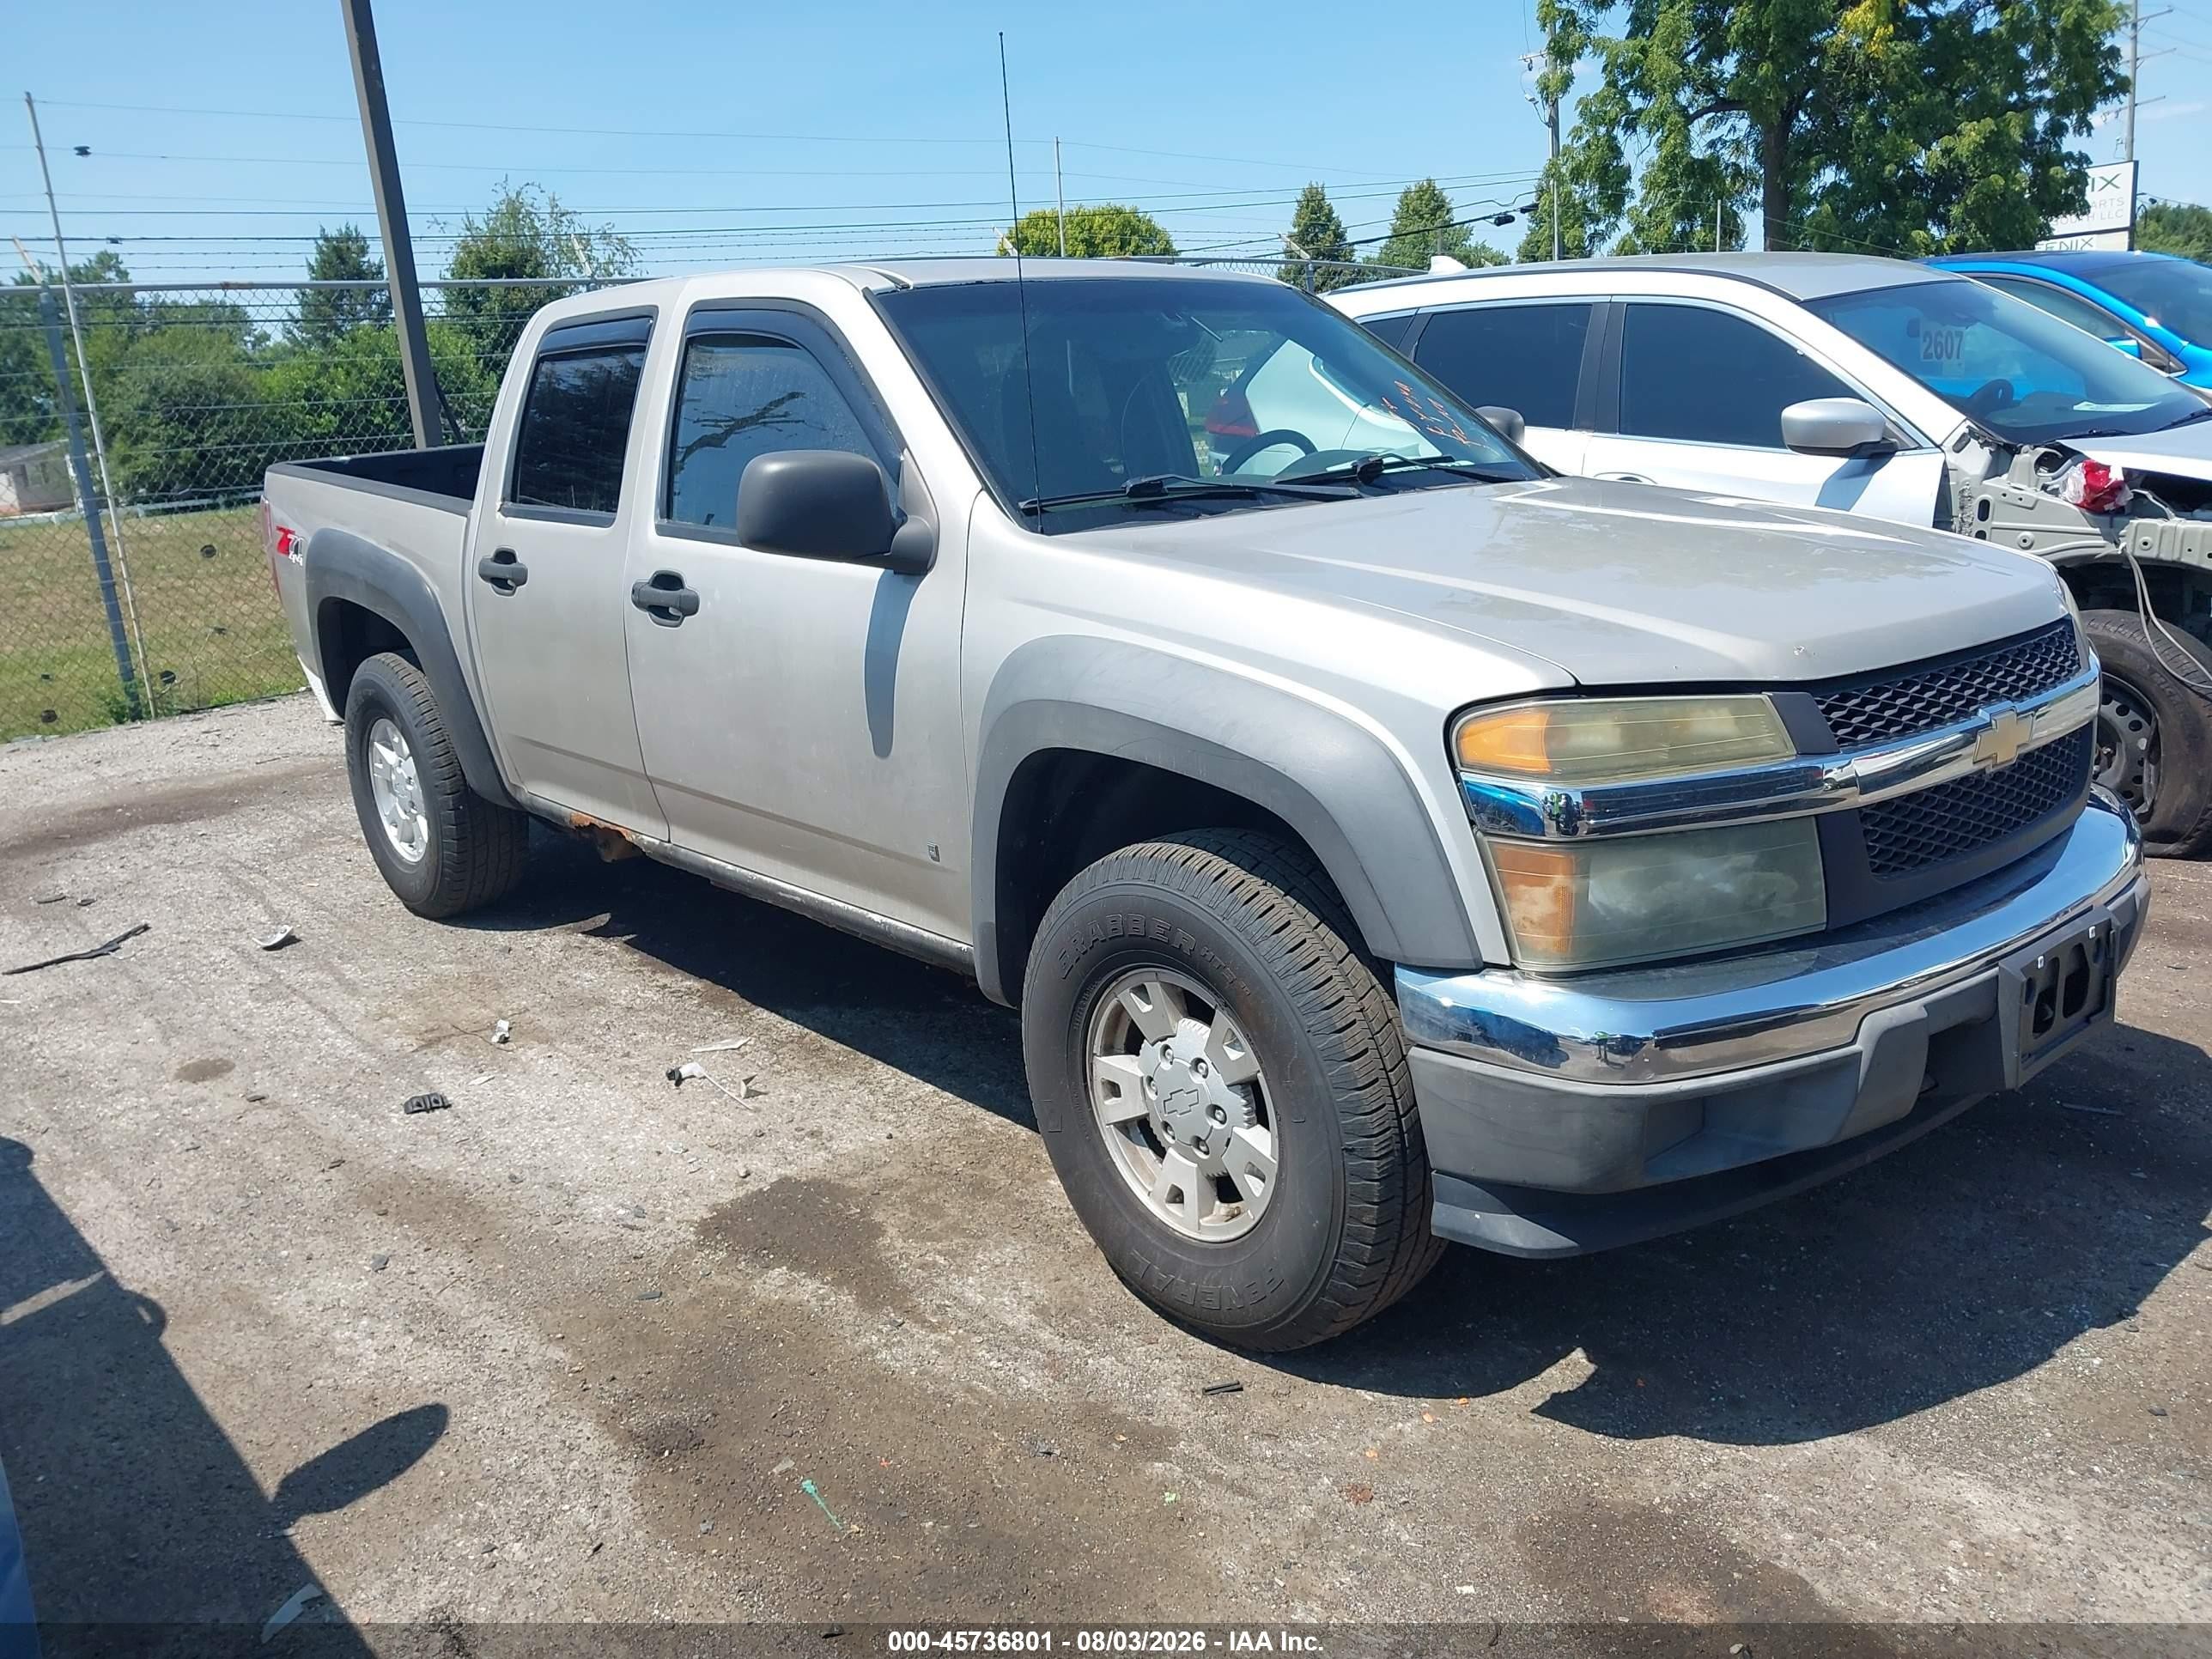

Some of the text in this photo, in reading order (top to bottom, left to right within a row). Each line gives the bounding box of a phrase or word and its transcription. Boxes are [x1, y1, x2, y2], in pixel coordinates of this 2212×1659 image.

[2100, 209, 2124, 221] LLC
[1923, 330, 1964, 361] 2607
[1058, 912, 1197, 979] GRABBER
[1129, 1249, 1285, 1310] GENERAL
